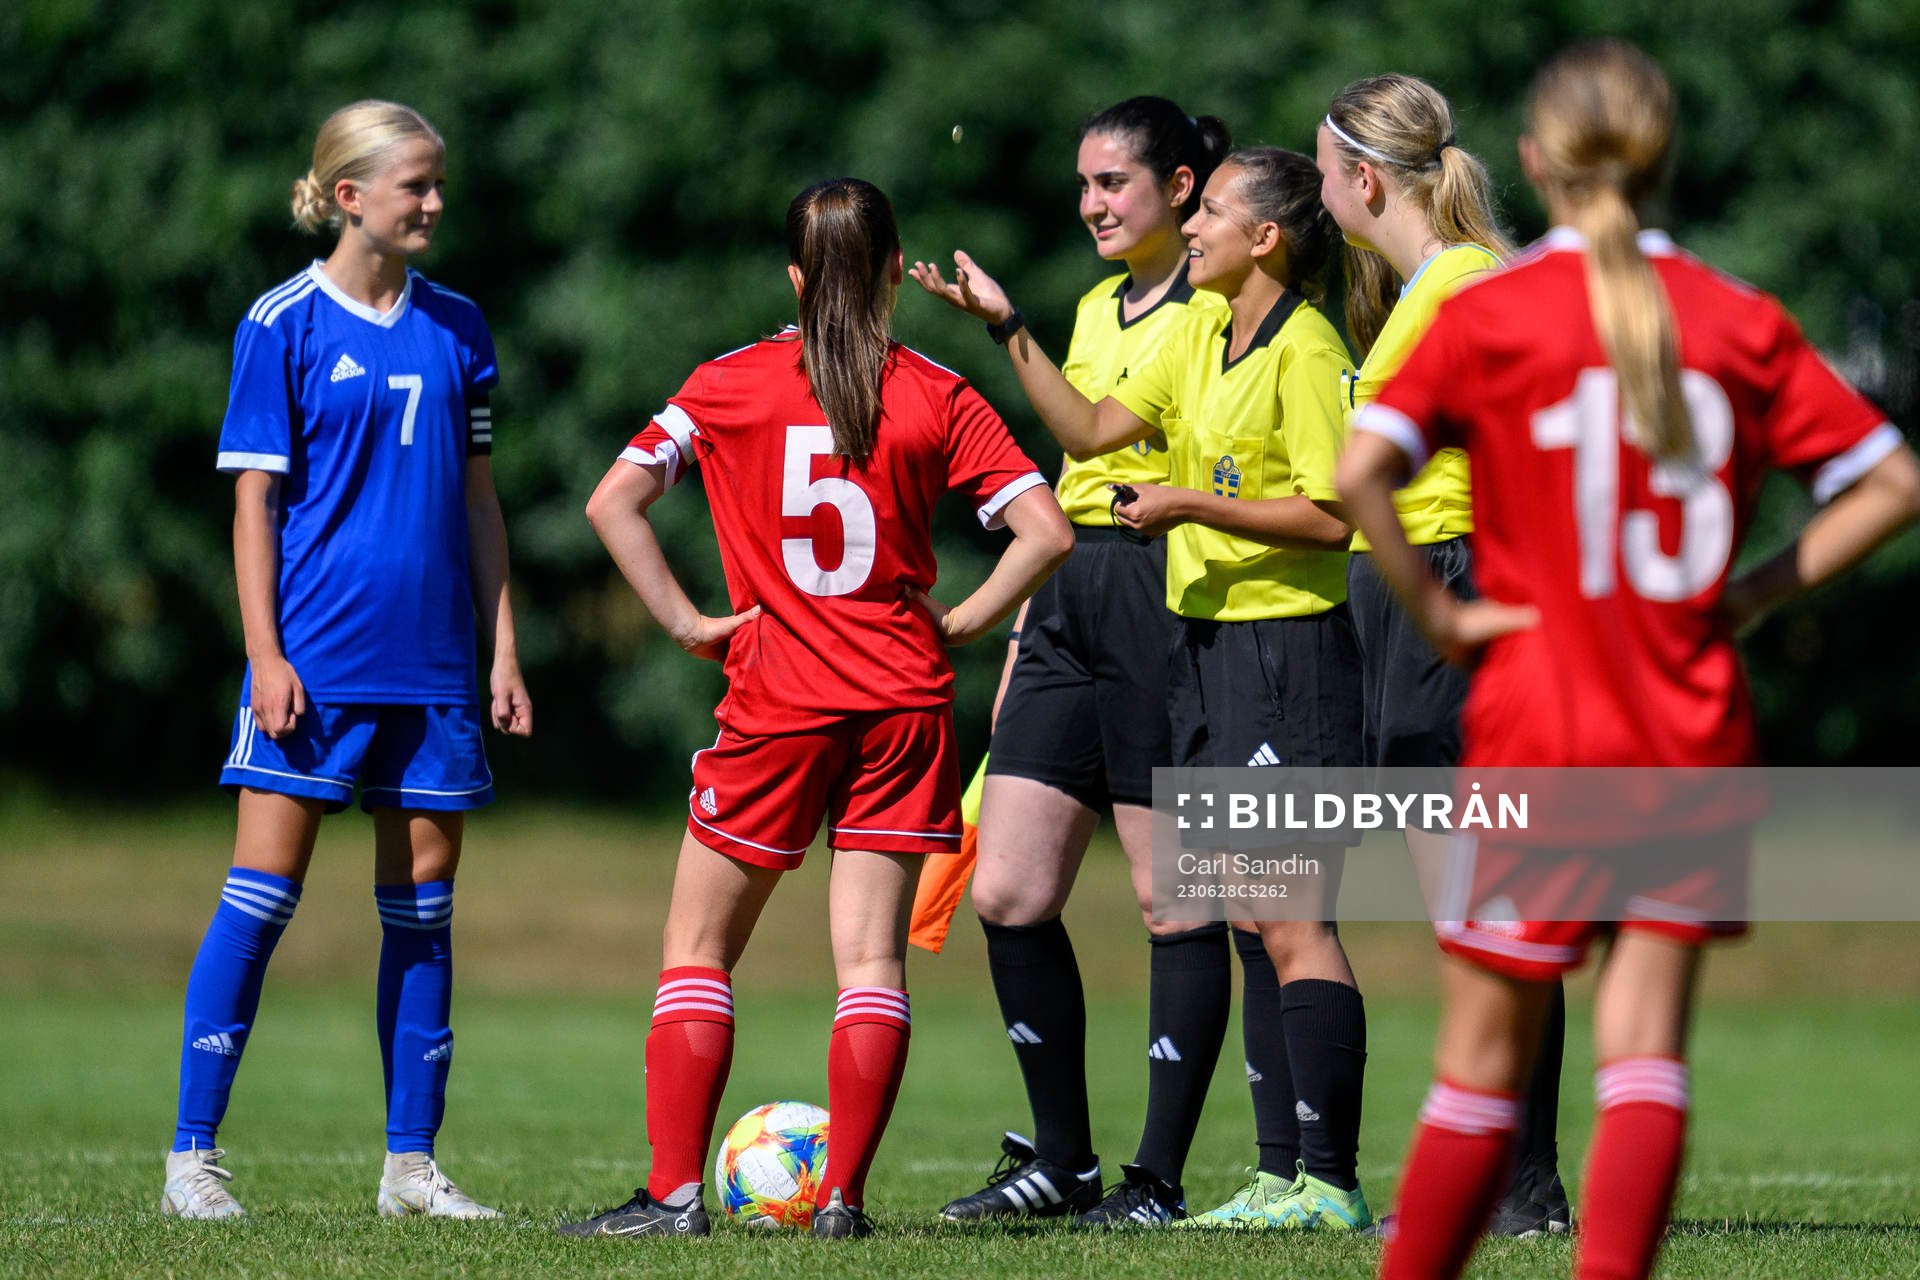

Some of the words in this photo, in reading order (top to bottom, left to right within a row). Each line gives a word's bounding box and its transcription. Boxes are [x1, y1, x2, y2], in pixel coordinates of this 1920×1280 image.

[387, 374, 423, 445] 7
[1530, 366, 1736, 602] 13
[781, 425, 876, 597] 5
